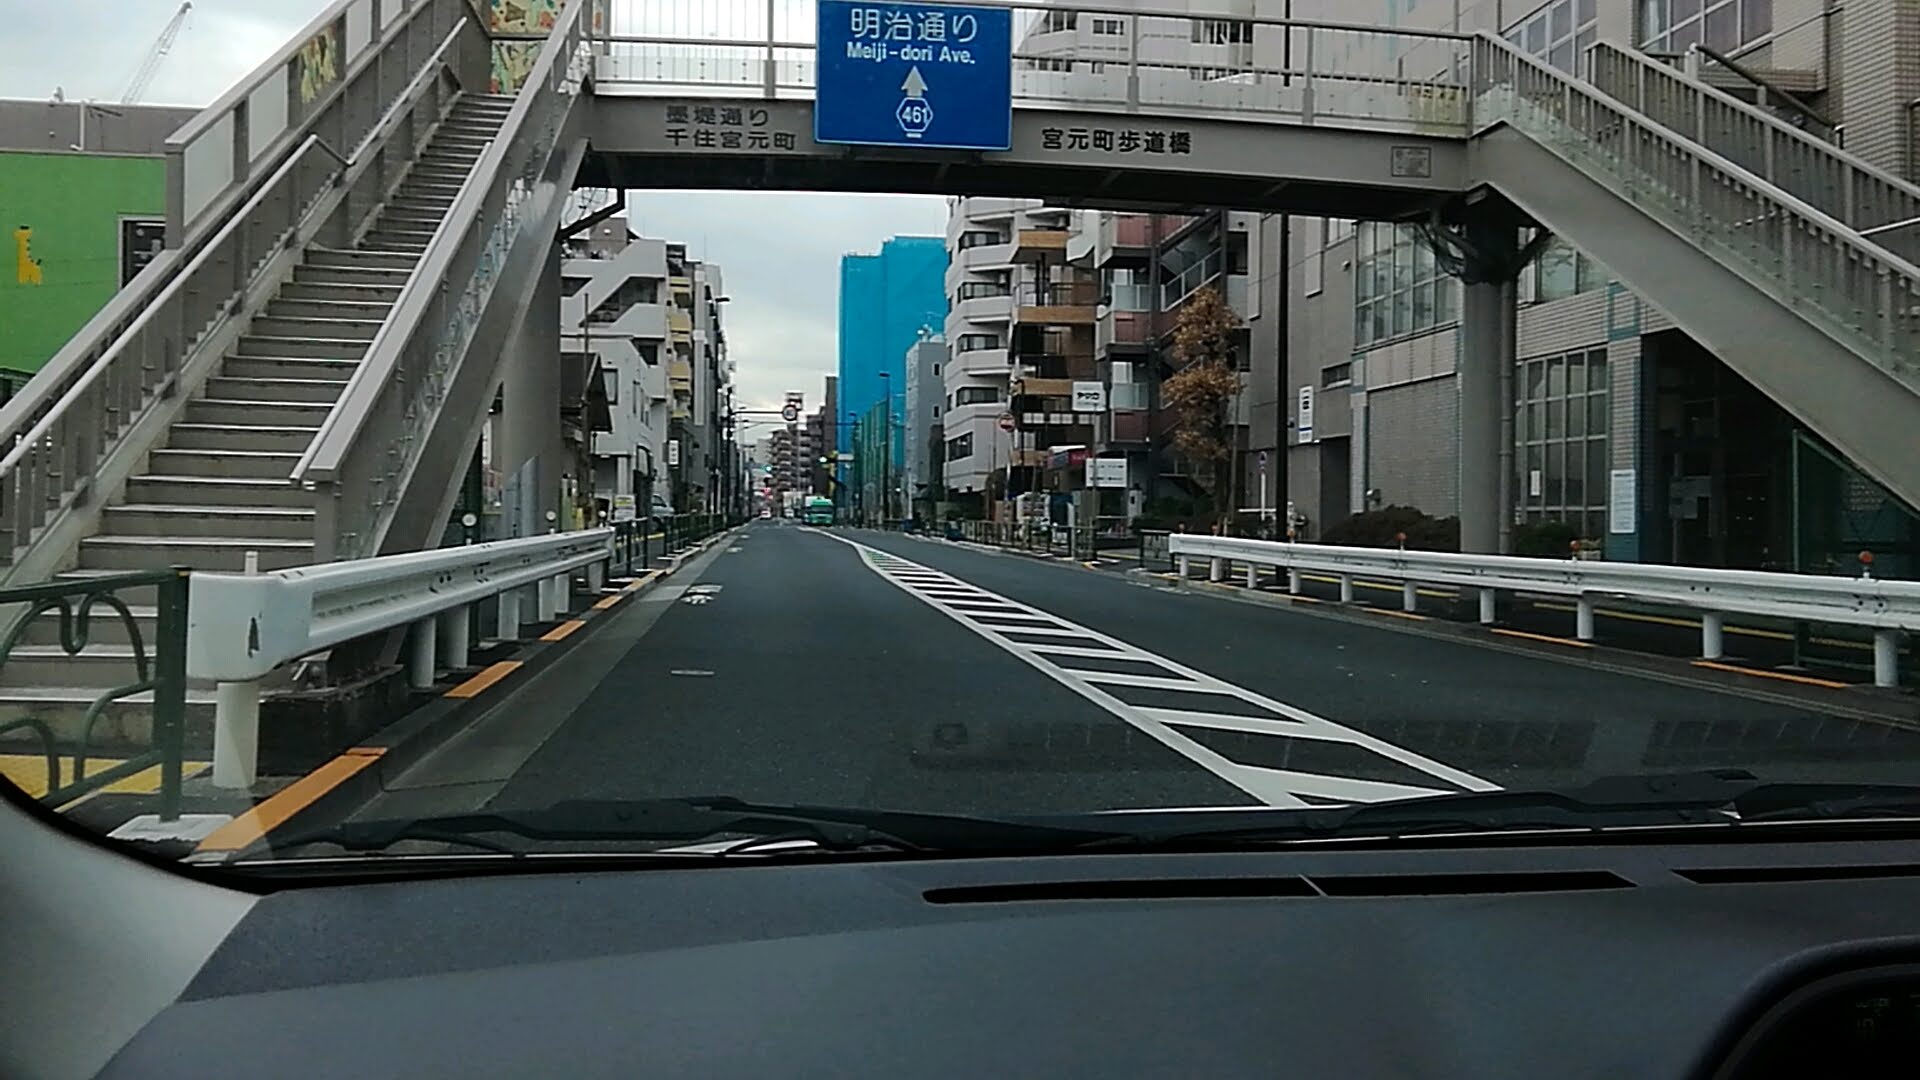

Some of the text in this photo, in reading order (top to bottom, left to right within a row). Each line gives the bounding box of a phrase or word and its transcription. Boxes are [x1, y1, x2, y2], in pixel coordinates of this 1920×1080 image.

[851, 8, 978, 43] 明治通り
[847, 41, 976, 65] Meiji-dori Ave.
[666, 105, 768, 127] 墨堤通り
[902, 106, 929, 124] 461
[665, 128, 796, 151] 千住宮元町
[1042, 127, 1191, 154] 宮元町歩道橋
